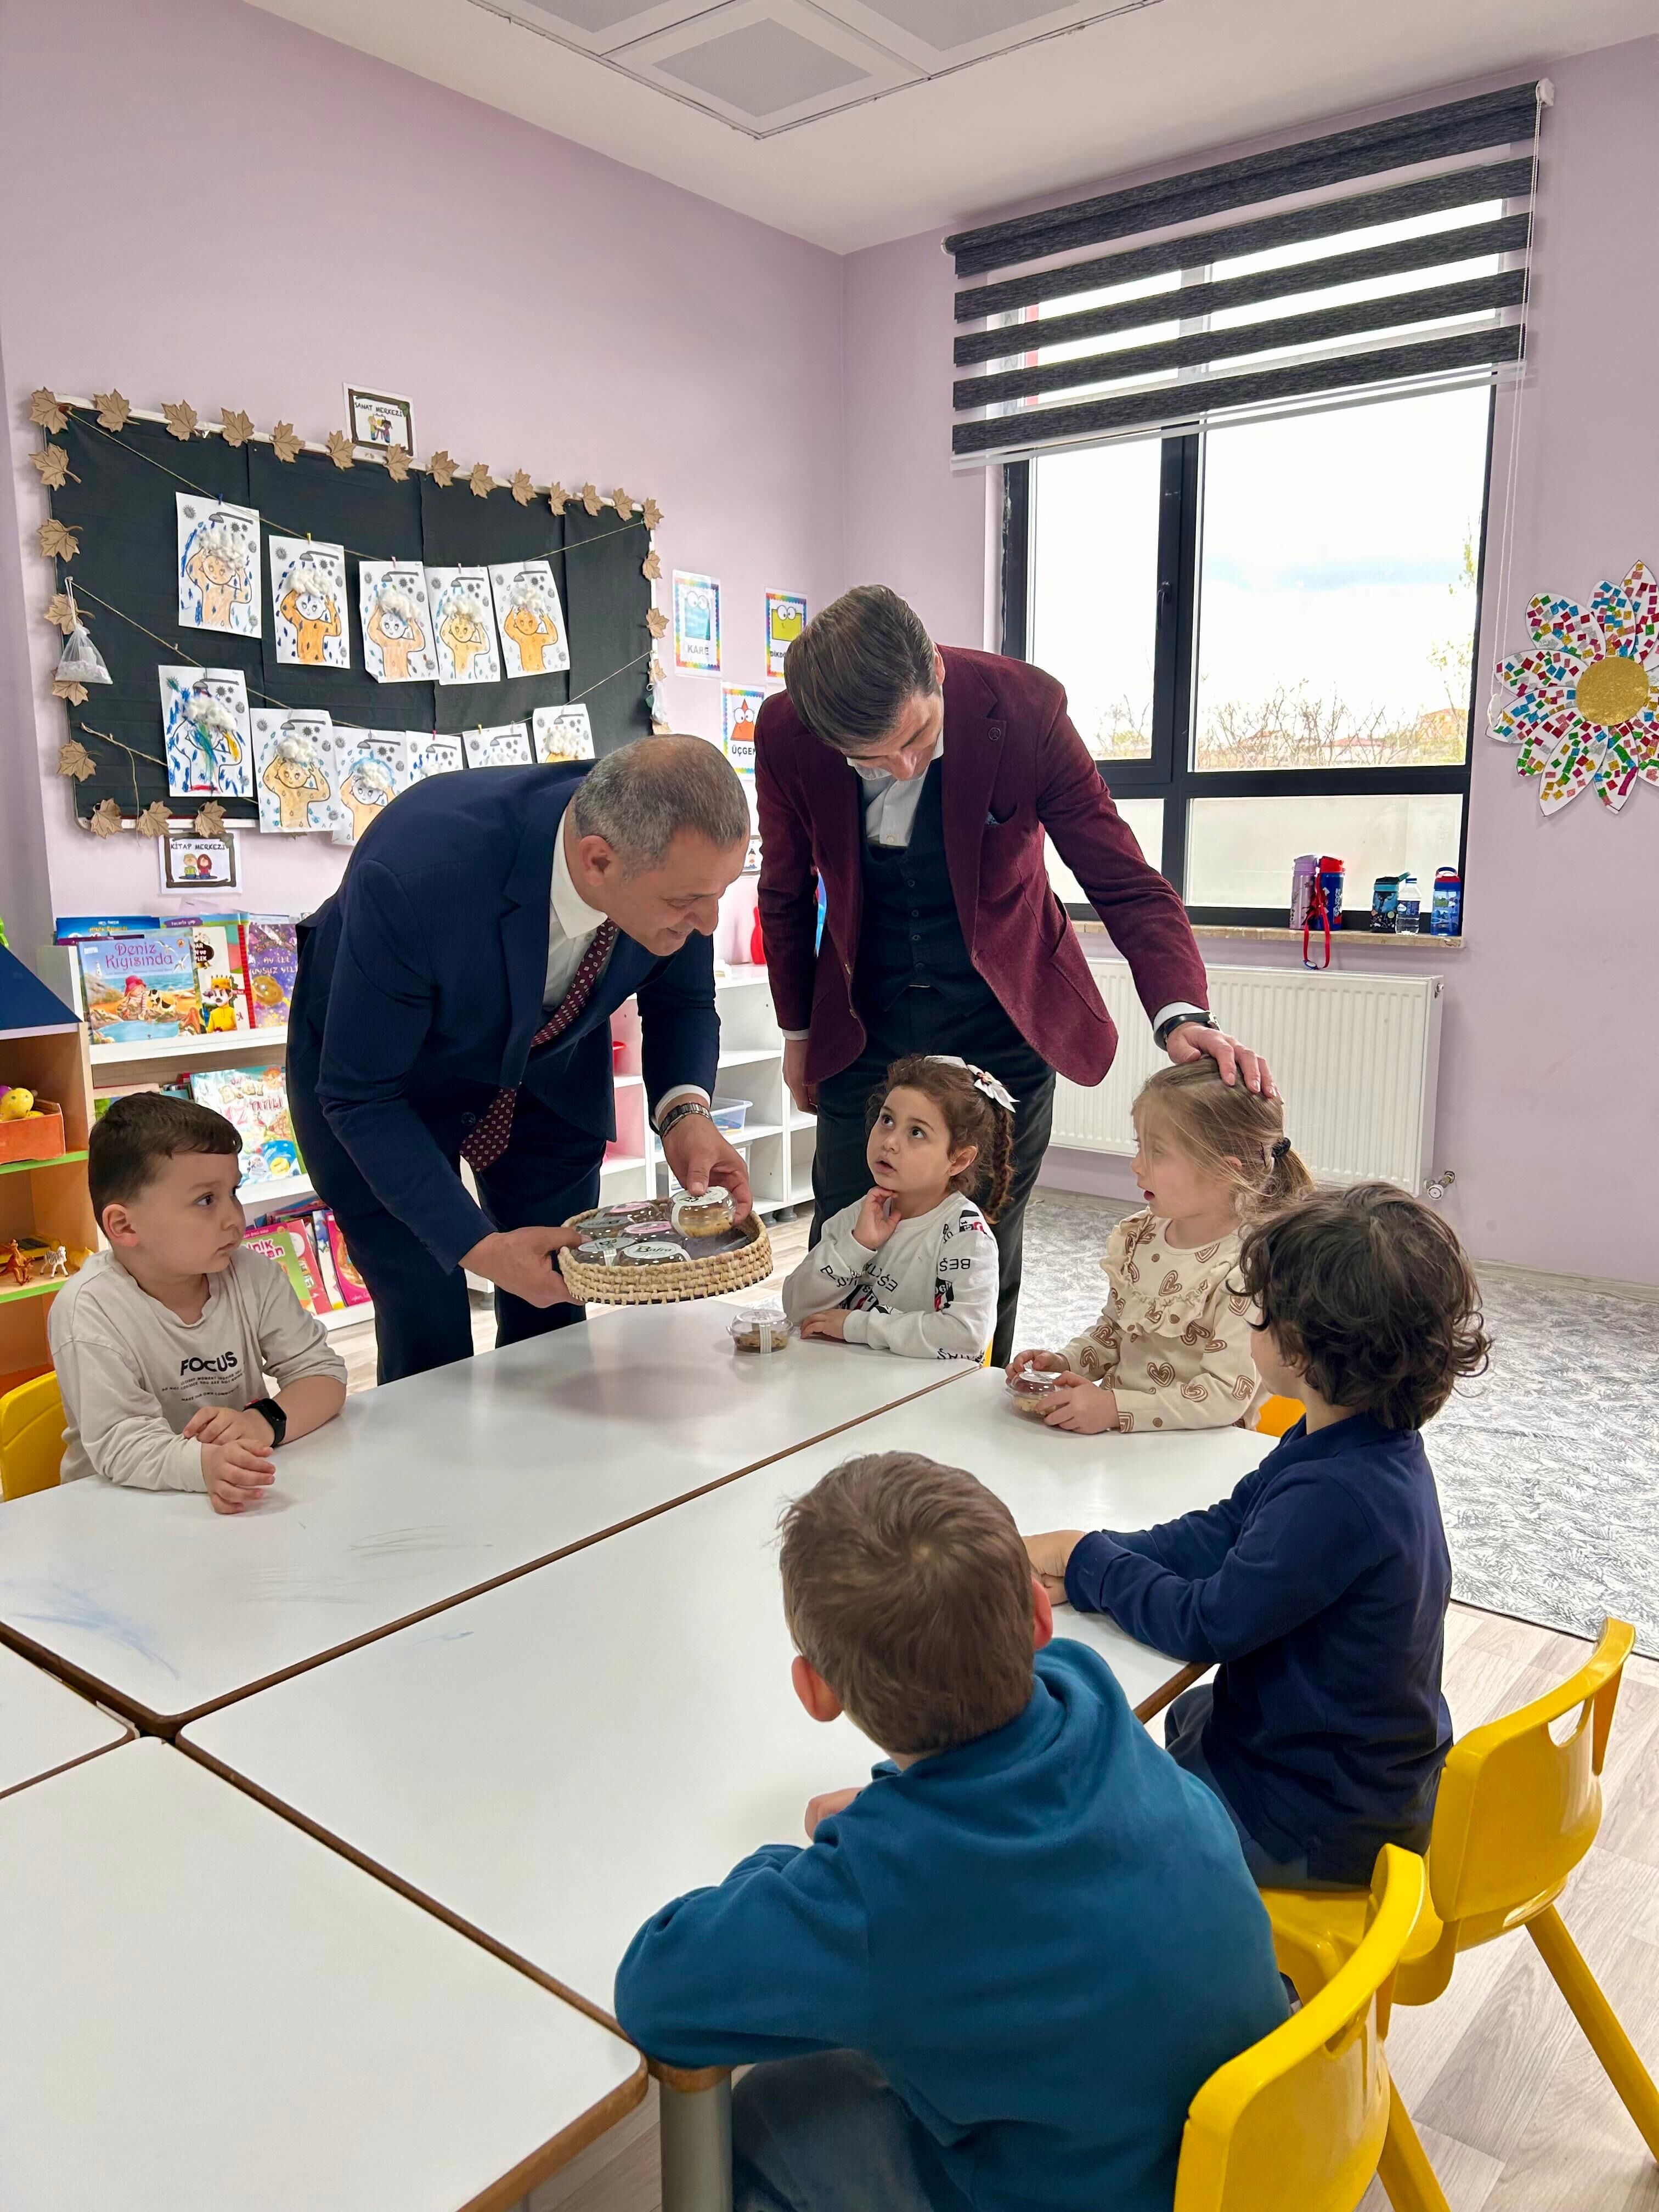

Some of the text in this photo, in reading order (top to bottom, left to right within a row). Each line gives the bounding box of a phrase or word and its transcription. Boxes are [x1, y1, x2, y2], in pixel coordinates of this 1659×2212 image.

[354, 402, 373, 411] SANAT
[687, 645, 709, 656] KARE
[115, 941, 156, 956] Deniz
[105, 952, 173, 970] Kıyısında
[635, 1244, 672, 1252] Bafra
[939, 1257, 971, 1272] BEŞ
[180, 1351, 238, 1376] FOCUS
